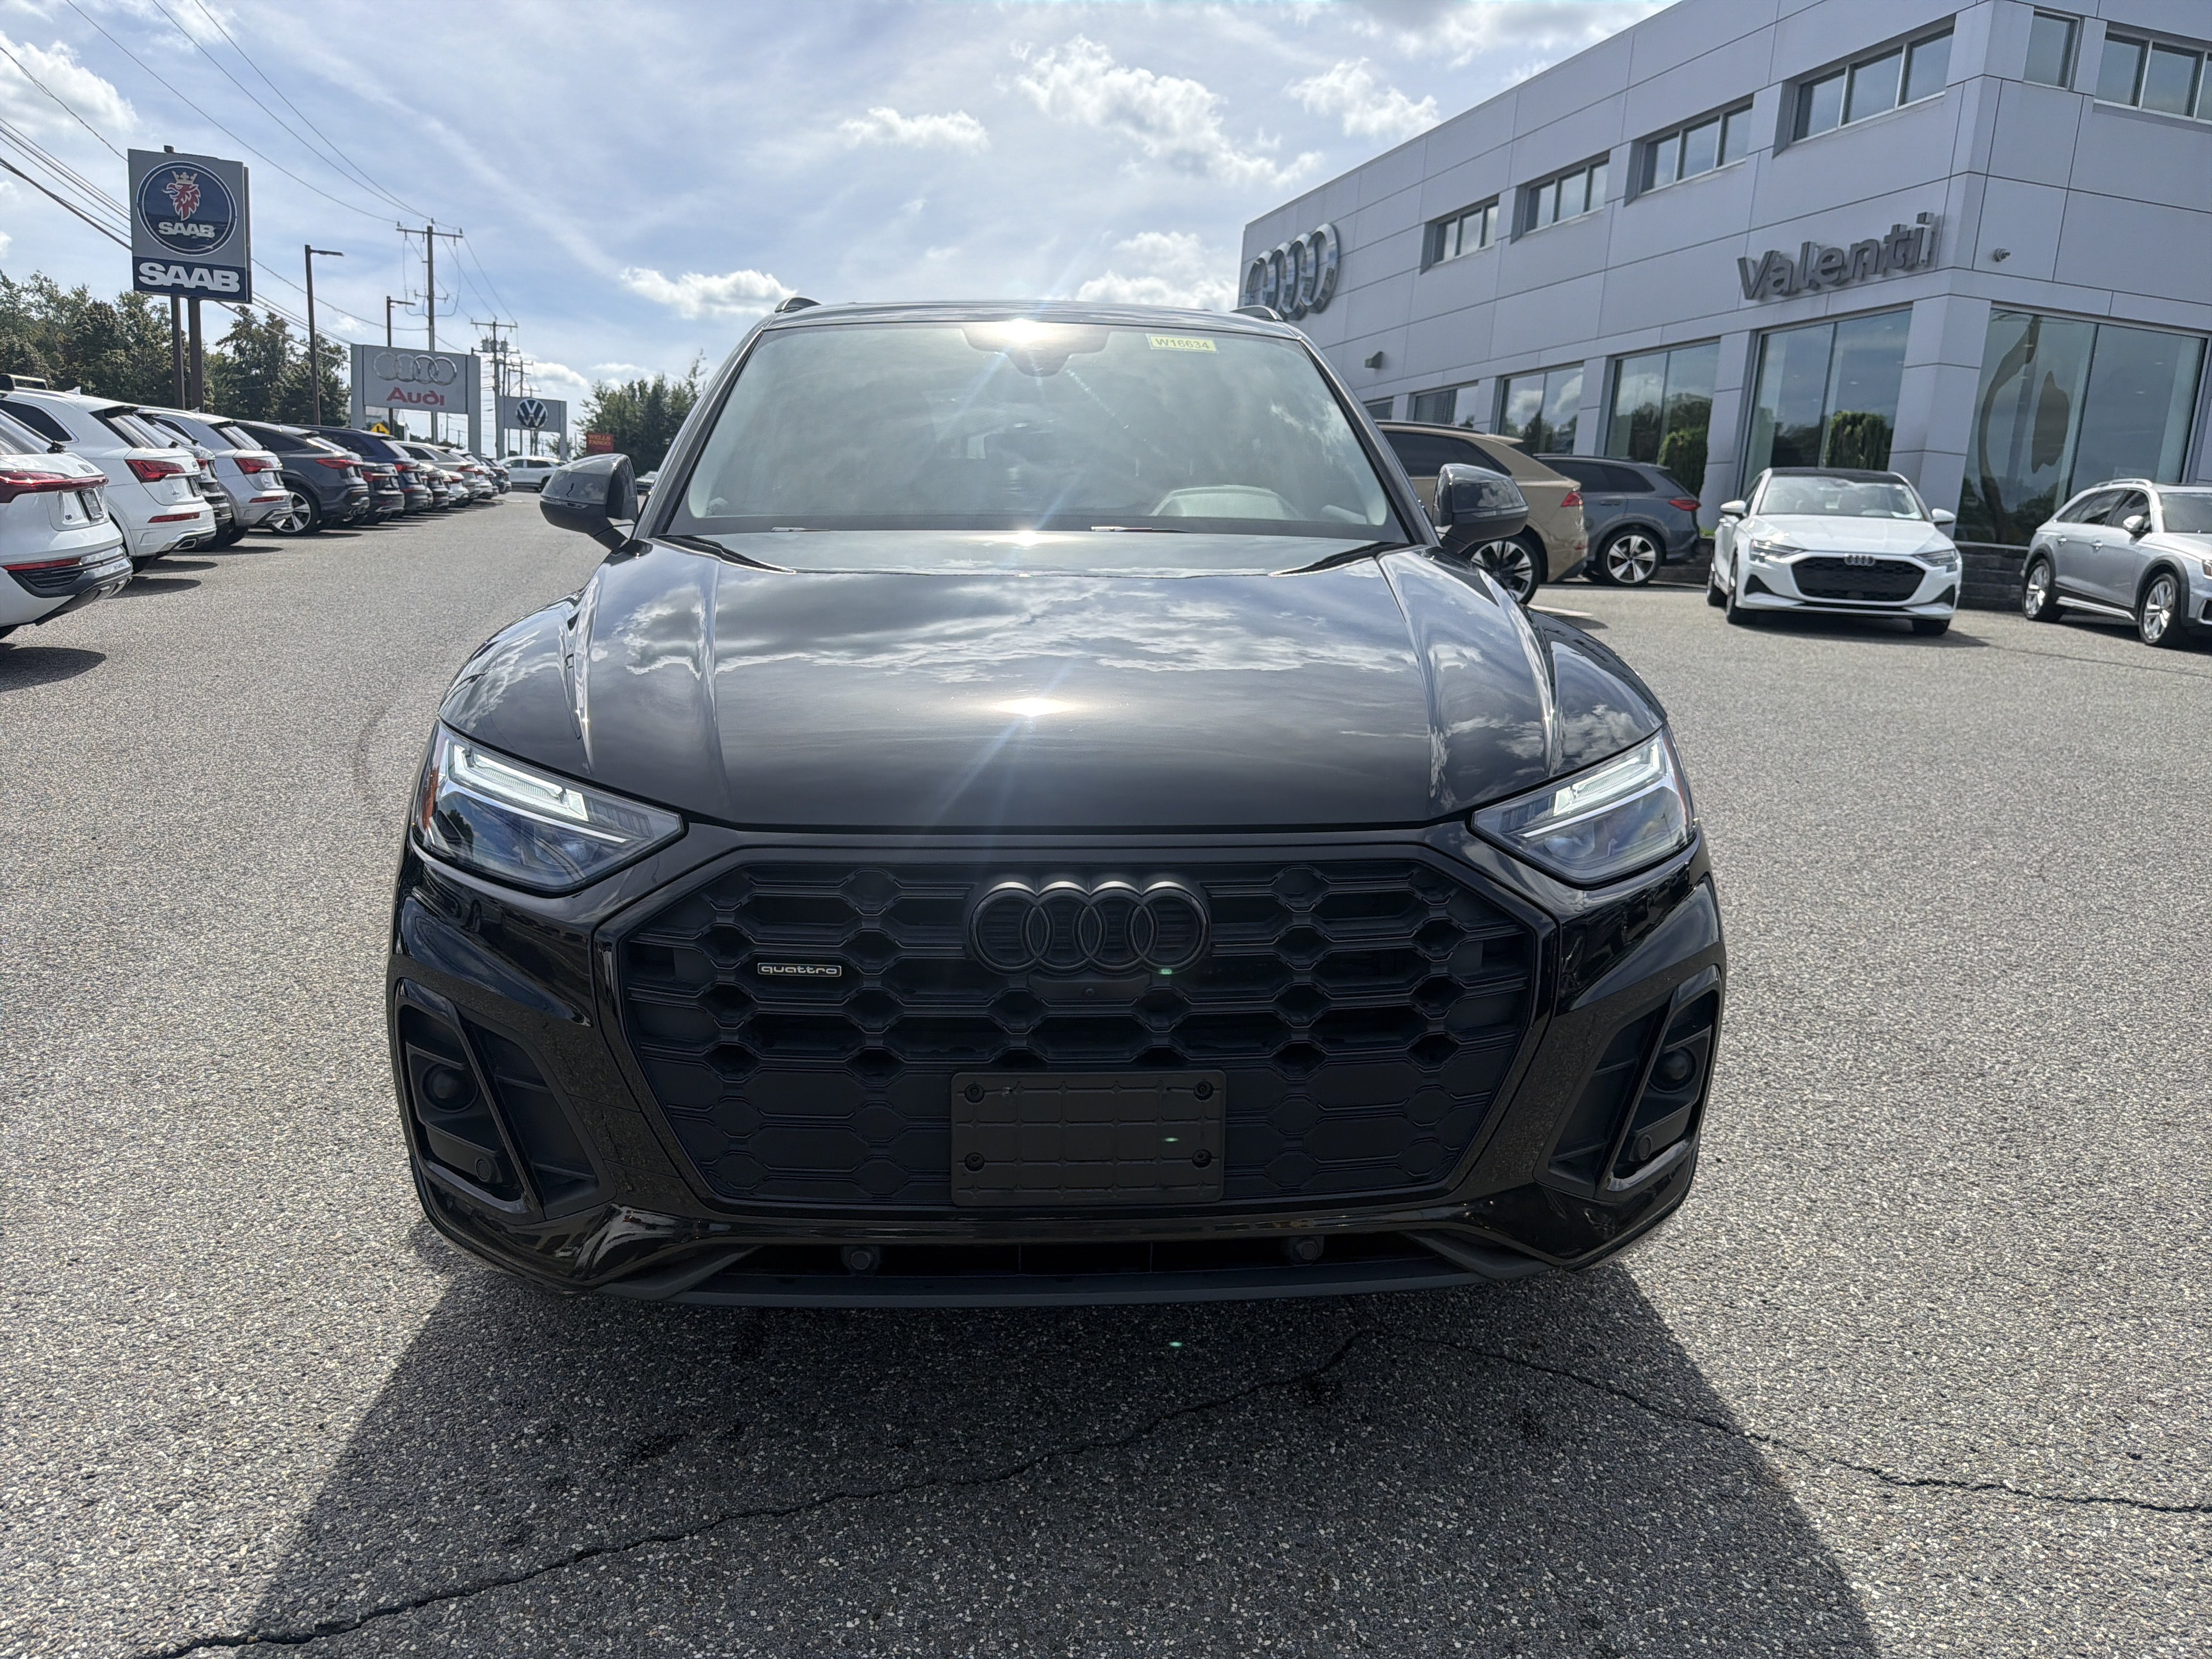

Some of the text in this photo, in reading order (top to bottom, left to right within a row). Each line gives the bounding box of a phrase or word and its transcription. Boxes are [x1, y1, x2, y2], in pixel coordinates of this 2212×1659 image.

[158, 222, 215, 238] SAAB
[1737, 212, 1935, 300] Valenti
[138, 262, 240, 293] SAAB
[1155, 338, 1210, 349] W16634
[386, 387, 445, 406] Audi
[761, 966, 838, 974] quattro
